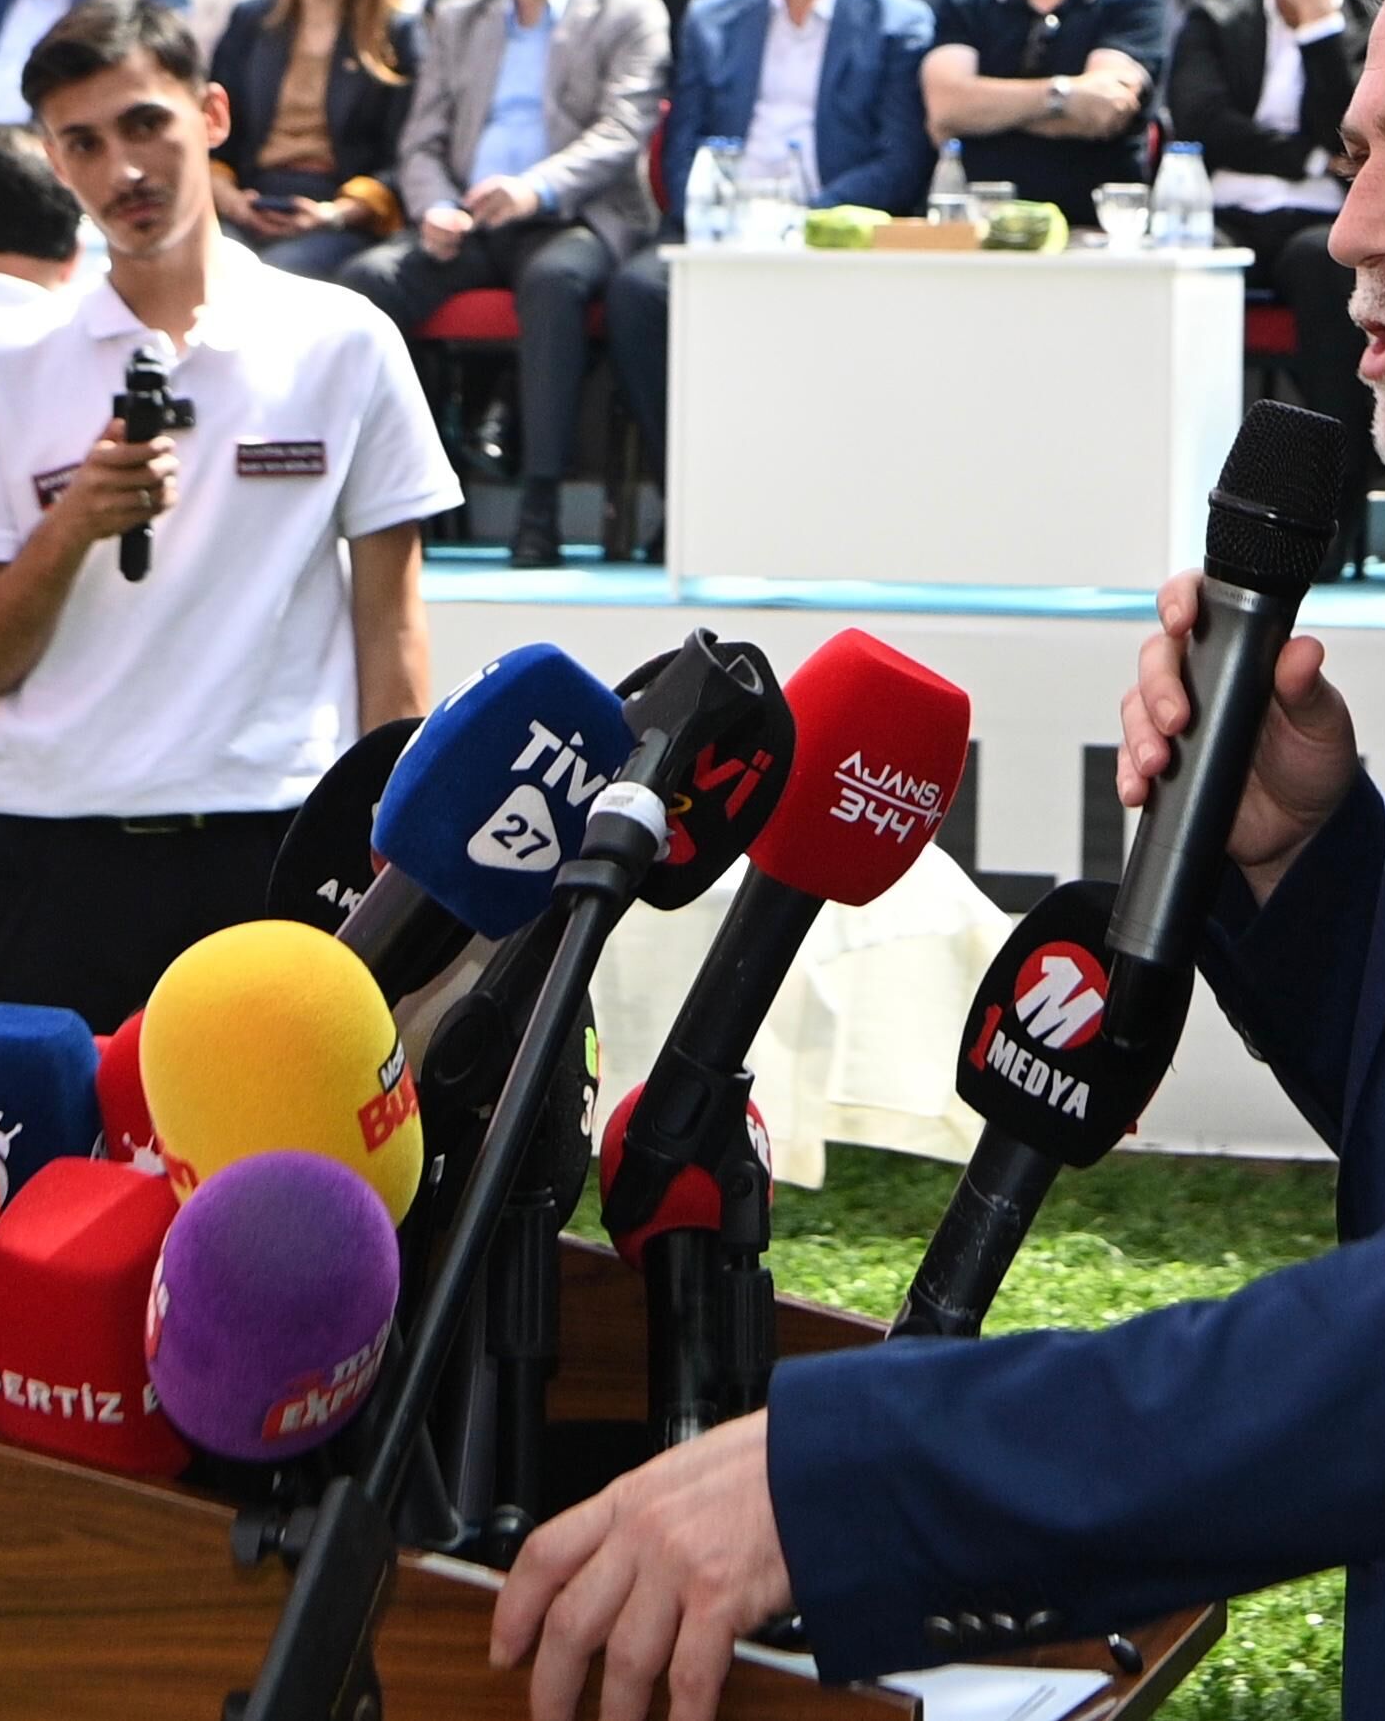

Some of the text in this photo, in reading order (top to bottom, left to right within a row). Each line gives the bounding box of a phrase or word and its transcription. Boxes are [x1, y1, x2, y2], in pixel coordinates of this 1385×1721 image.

[510, 719, 622, 808] TİV
[838, 749, 940, 808] AJANS
[491, 813, 552, 861] 27
[829, 787, 915, 845] 344
